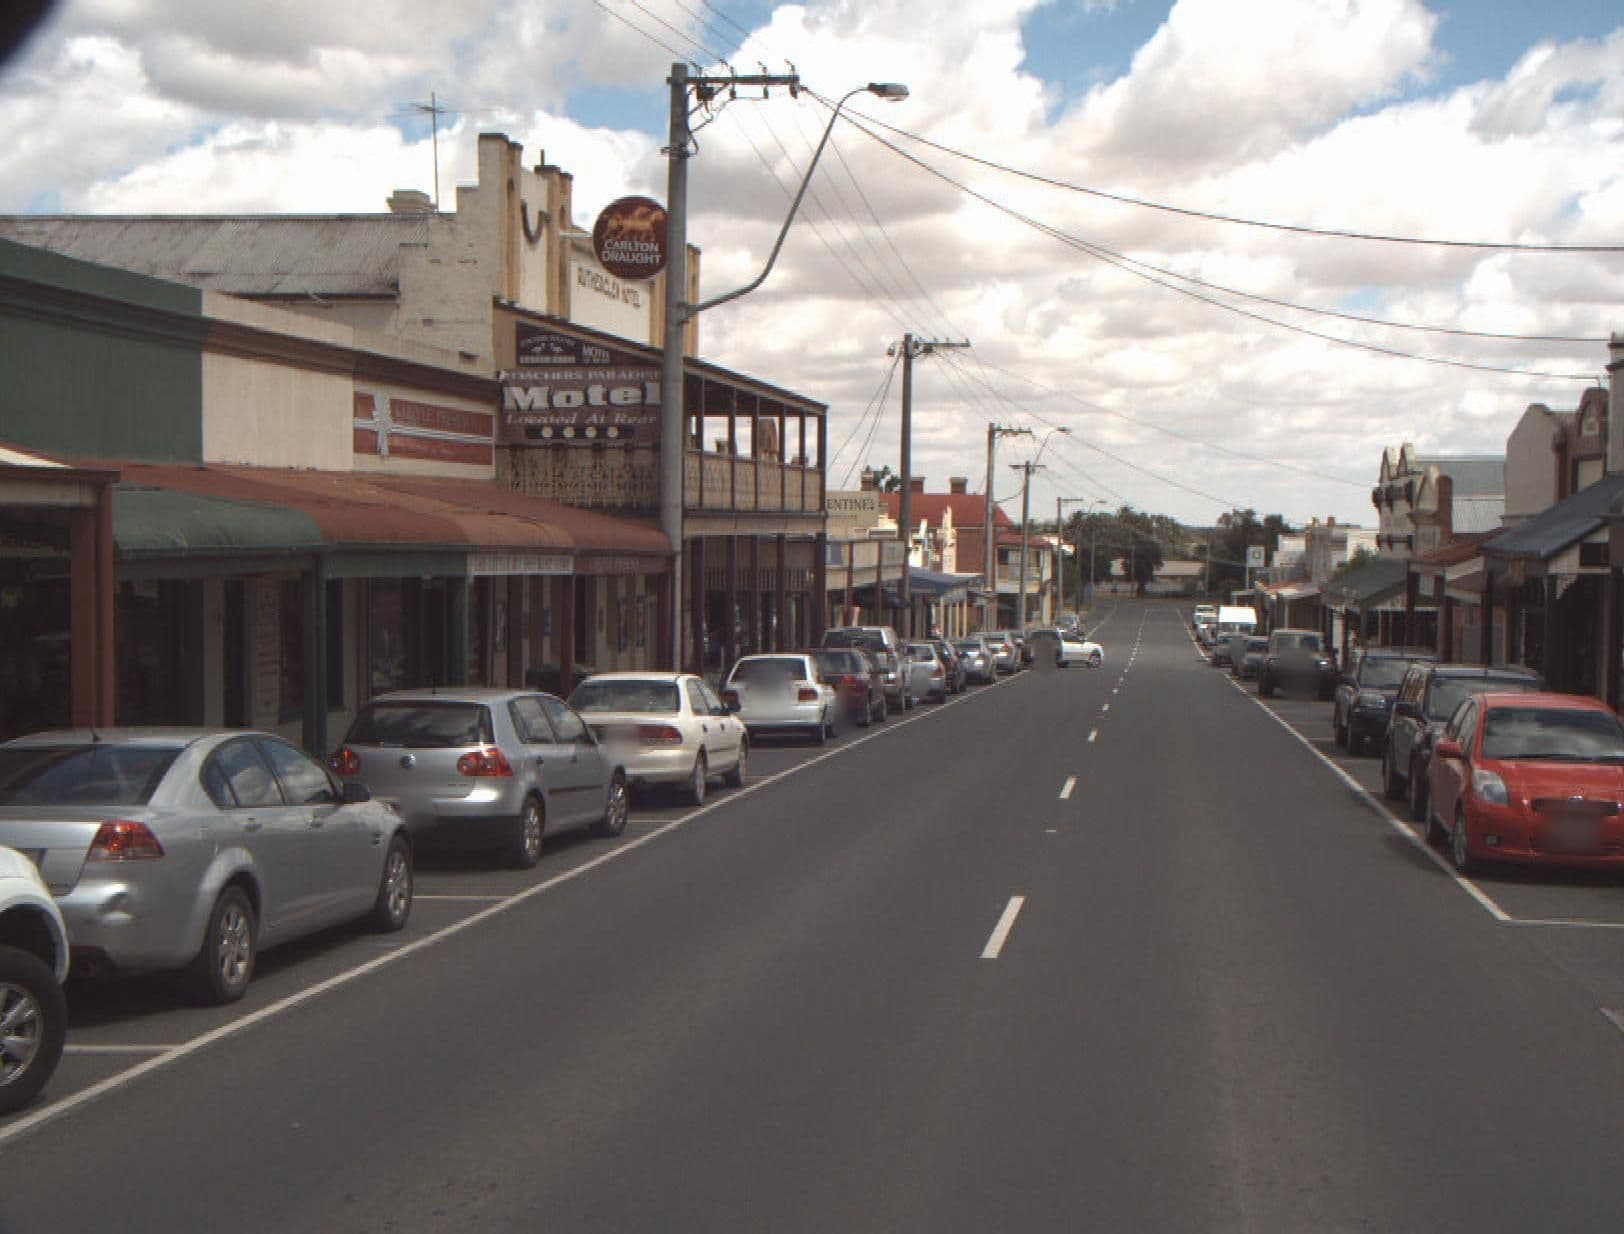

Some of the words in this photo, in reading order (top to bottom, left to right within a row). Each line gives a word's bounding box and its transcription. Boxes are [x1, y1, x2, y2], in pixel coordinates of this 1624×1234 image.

[604, 239, 659, 252] CARLTON
[601, 251, 662, 264] DRAUGHT
[503, 382, 661, 411] Motel
[506, 412, 577, 424] Located
[585, 413, 607, 424] At
[614, 412, 658, 424] Rear
